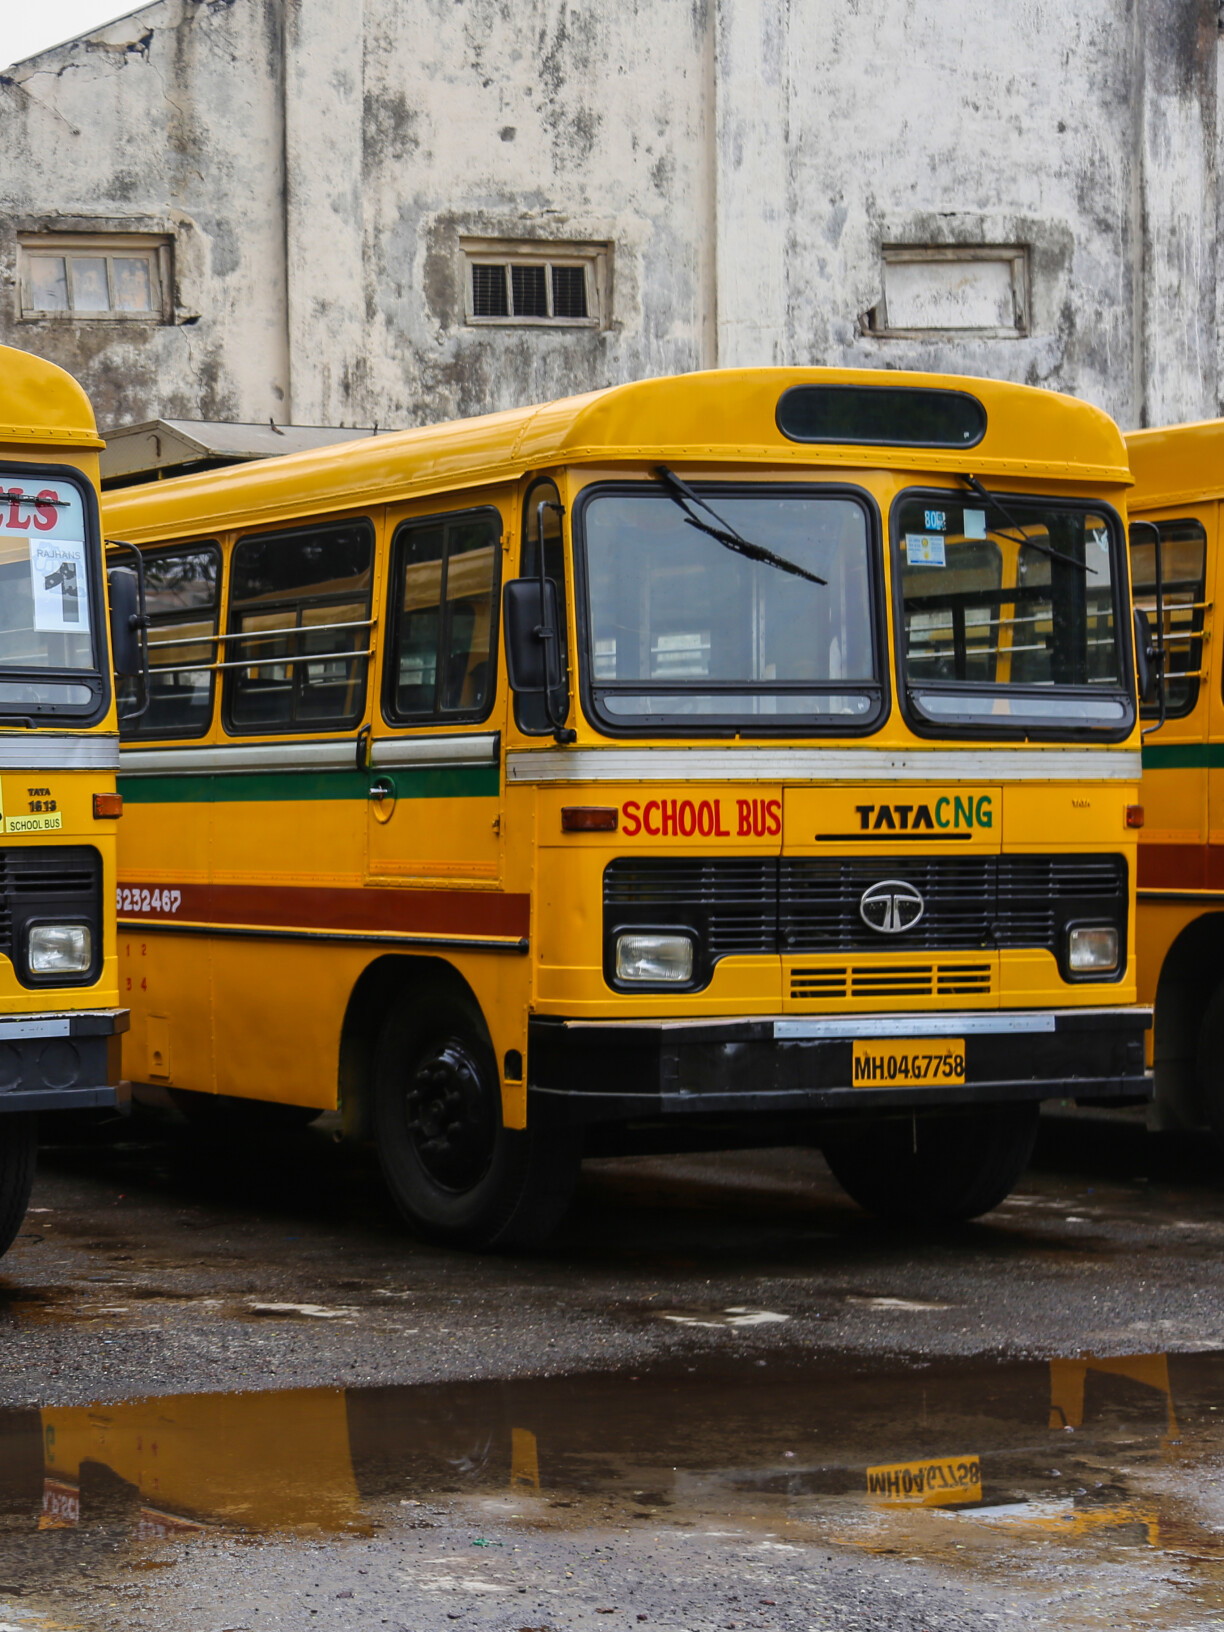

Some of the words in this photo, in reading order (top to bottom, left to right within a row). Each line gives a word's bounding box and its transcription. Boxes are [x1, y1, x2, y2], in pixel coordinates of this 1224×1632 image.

[37, 549, 81, 559] RAJHANS
[44, 562, 80, 623] 1
[27, 788, 51, 796] TATA
[28, 800, 57, 812] 1613
[855, 805, 935, 829] TATA
[935, 796, 993, 828] CNG
[10, 820, 43, 831] SCHOOL
[44, 818, 61, 829] BUS
[622, 799, 730, 837] SCHOOL
[737, 799, 782, 836] BUS
